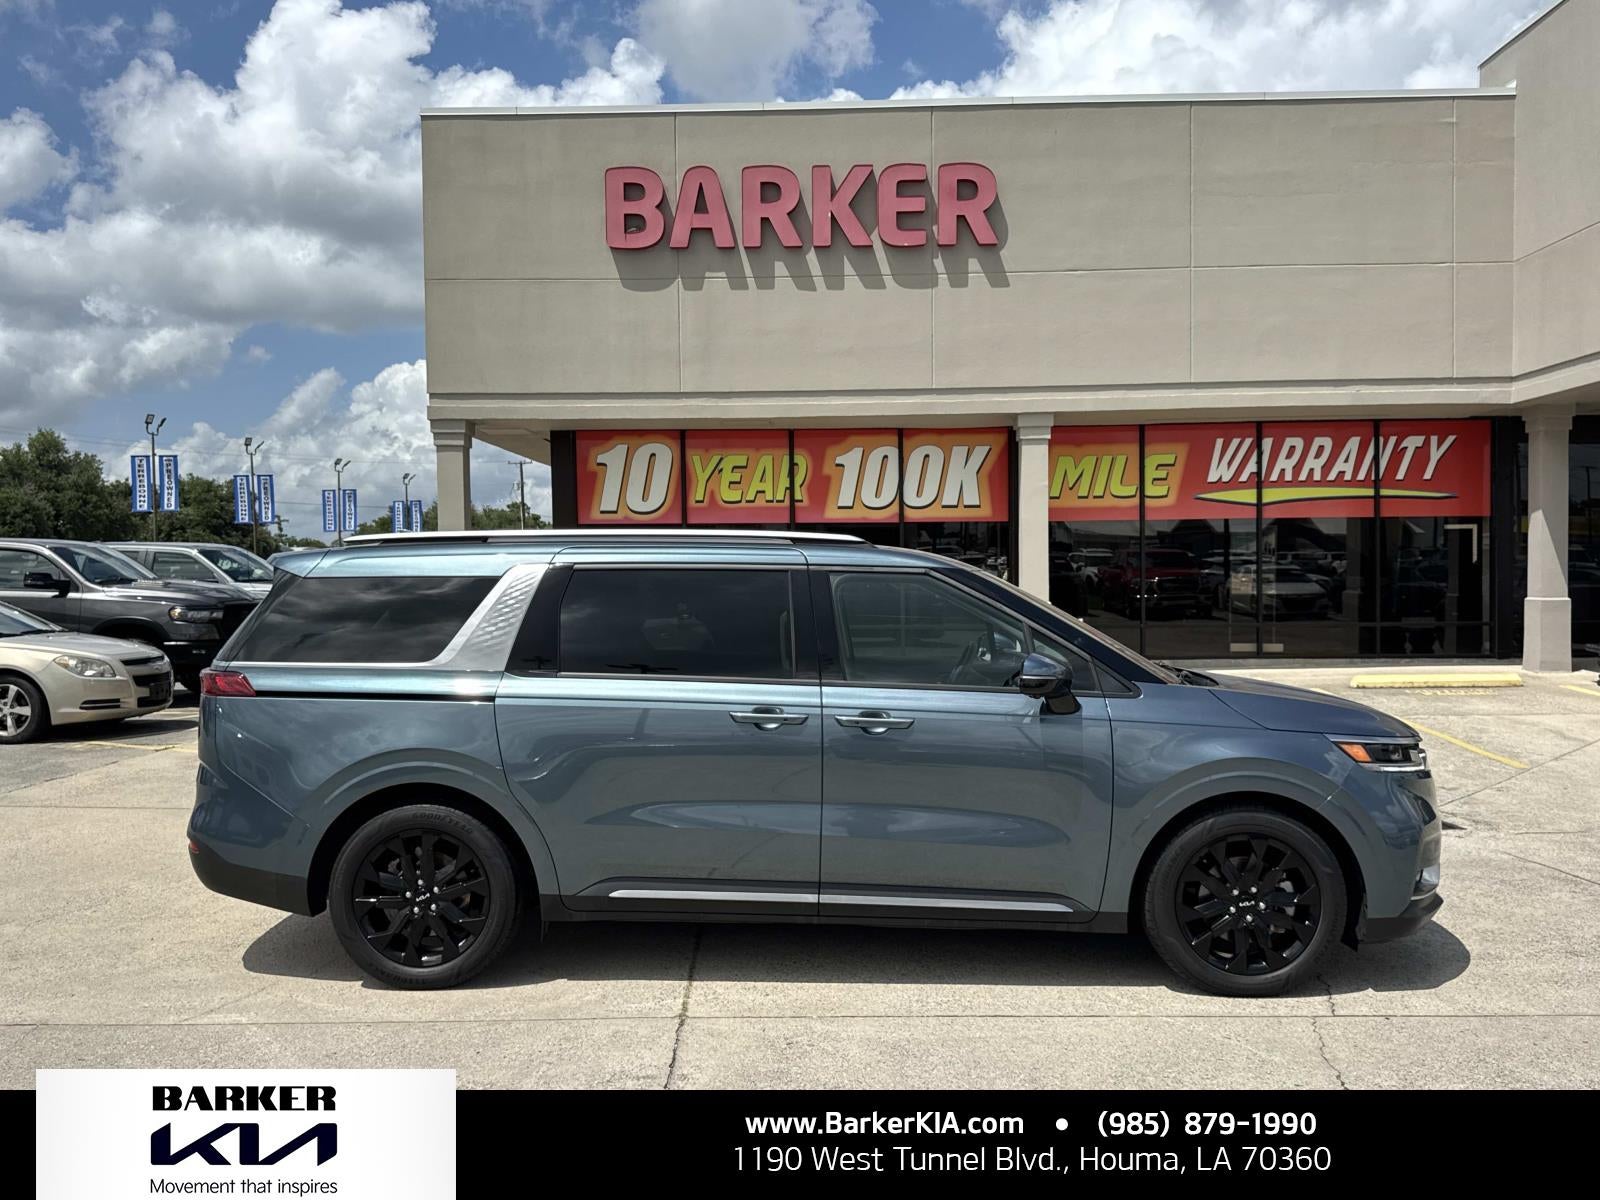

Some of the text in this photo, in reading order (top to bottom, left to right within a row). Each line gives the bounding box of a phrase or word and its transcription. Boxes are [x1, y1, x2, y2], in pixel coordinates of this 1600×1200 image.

[604, 161, 999, 249] BARKER
[595, 434, 1458, 515] 10 YEAR 100K MILE WARRANTY
